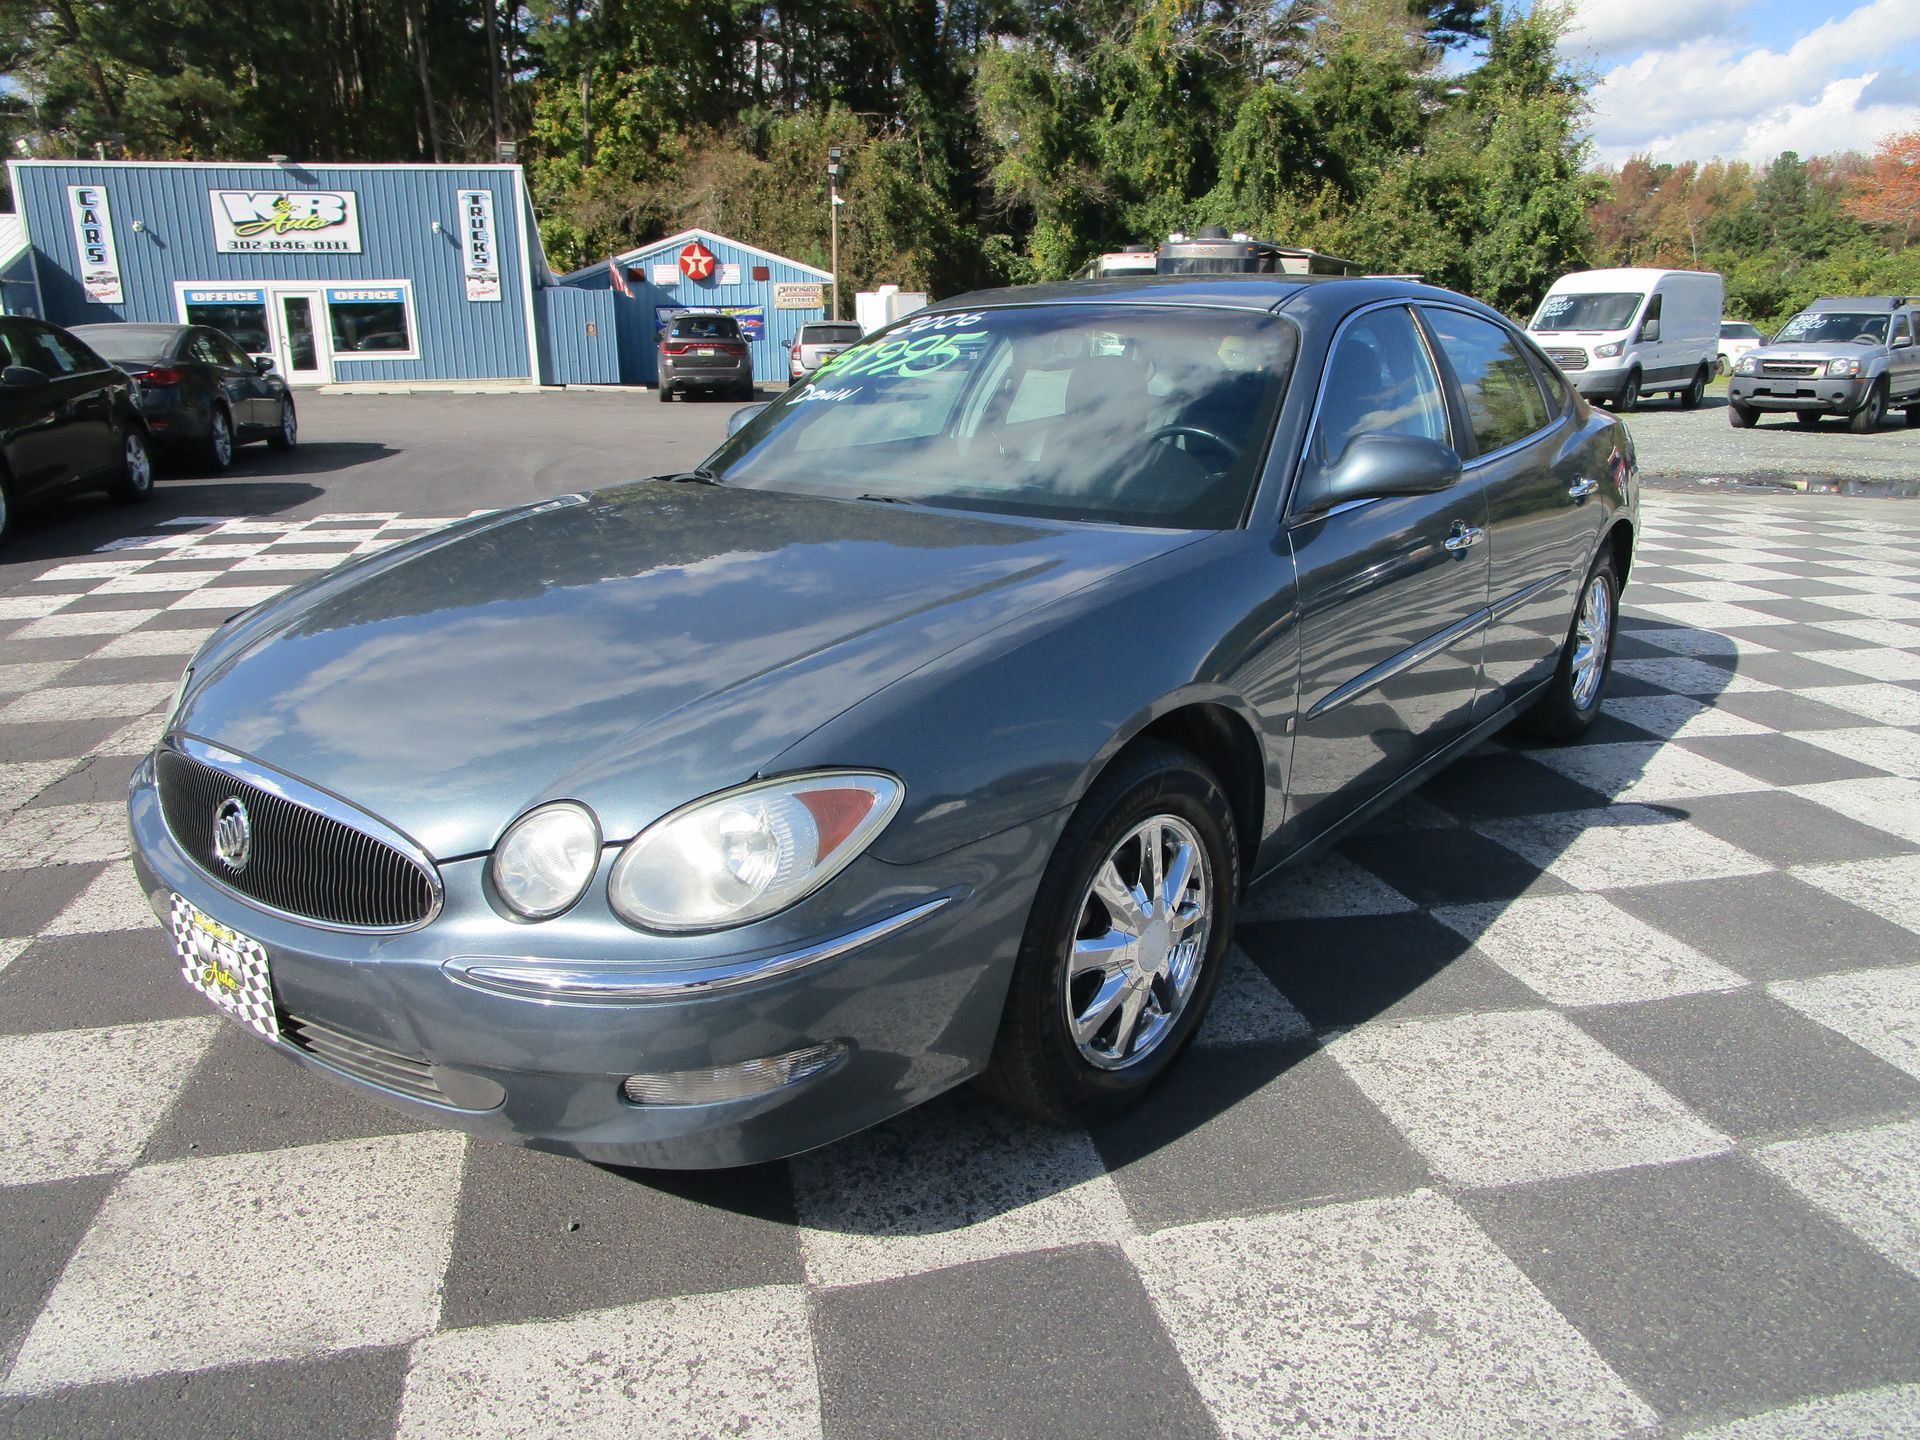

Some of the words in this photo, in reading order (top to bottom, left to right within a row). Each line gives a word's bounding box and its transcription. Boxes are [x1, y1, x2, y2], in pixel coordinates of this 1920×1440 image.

[77, 188, 104, 264] CARS
[235, 212, 332, 236] Auto
[462, 192, 490, 266] TRUCKS
[228, 240, 351, 250] 302-846-0111
[191, 291, 258, 302] OFFICE
[334, 290, 398, 300] OFFICE
[886, 312, 987, 336] 2006
[811, 331, 988, 378] $1995
[203, 959, 238, 991] Auto
